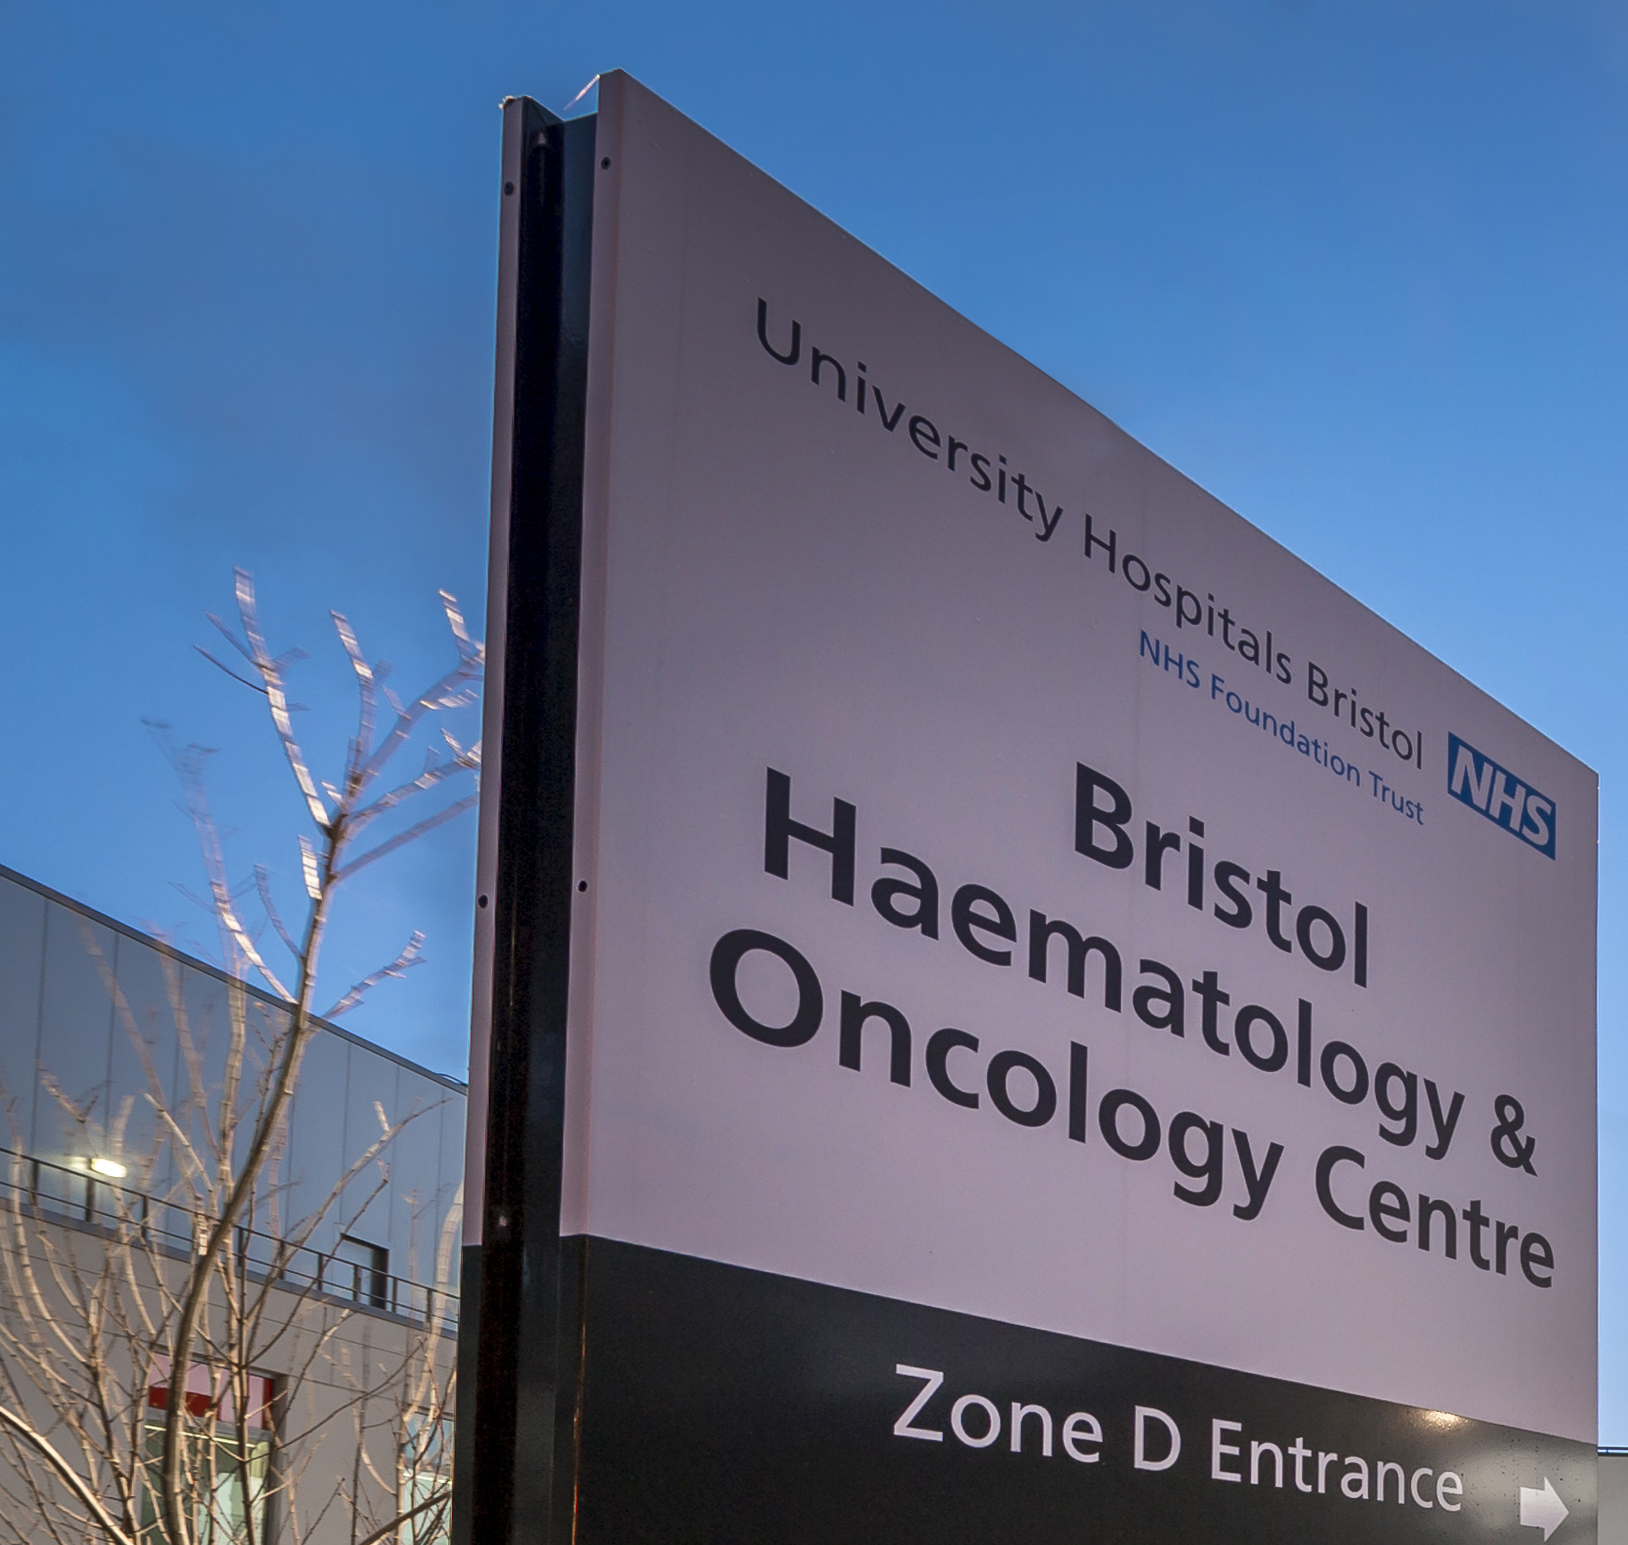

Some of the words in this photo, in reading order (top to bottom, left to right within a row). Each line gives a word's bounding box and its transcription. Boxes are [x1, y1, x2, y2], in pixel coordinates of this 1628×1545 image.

[757, 298, 1064, 544] University
[1083, 513, 1292, 688] Hospitals
[1308, 661, 1423, 771] Bristol
[1139, 627, 1201, 689] NHS
[1211, 673, 1361, 787] Foundation
[1369, 770, 1424, 826] Trust
[1451, 744, 1551, 847] NHS
[764, 767, 1466, 1161] Haematology
[1490, 1094, 1539, 1177] &
[1075, 762, 1368, 988] Bristol
[709, 928, 1285, 1221] Oncology
[1315, 1145, 1555, 1289] Centre
[893, 1363, 1104, 1464] Zone
[1133, 1404, 1182, 1472] D
[1210, 1417, 1464, 1513] Entrance
